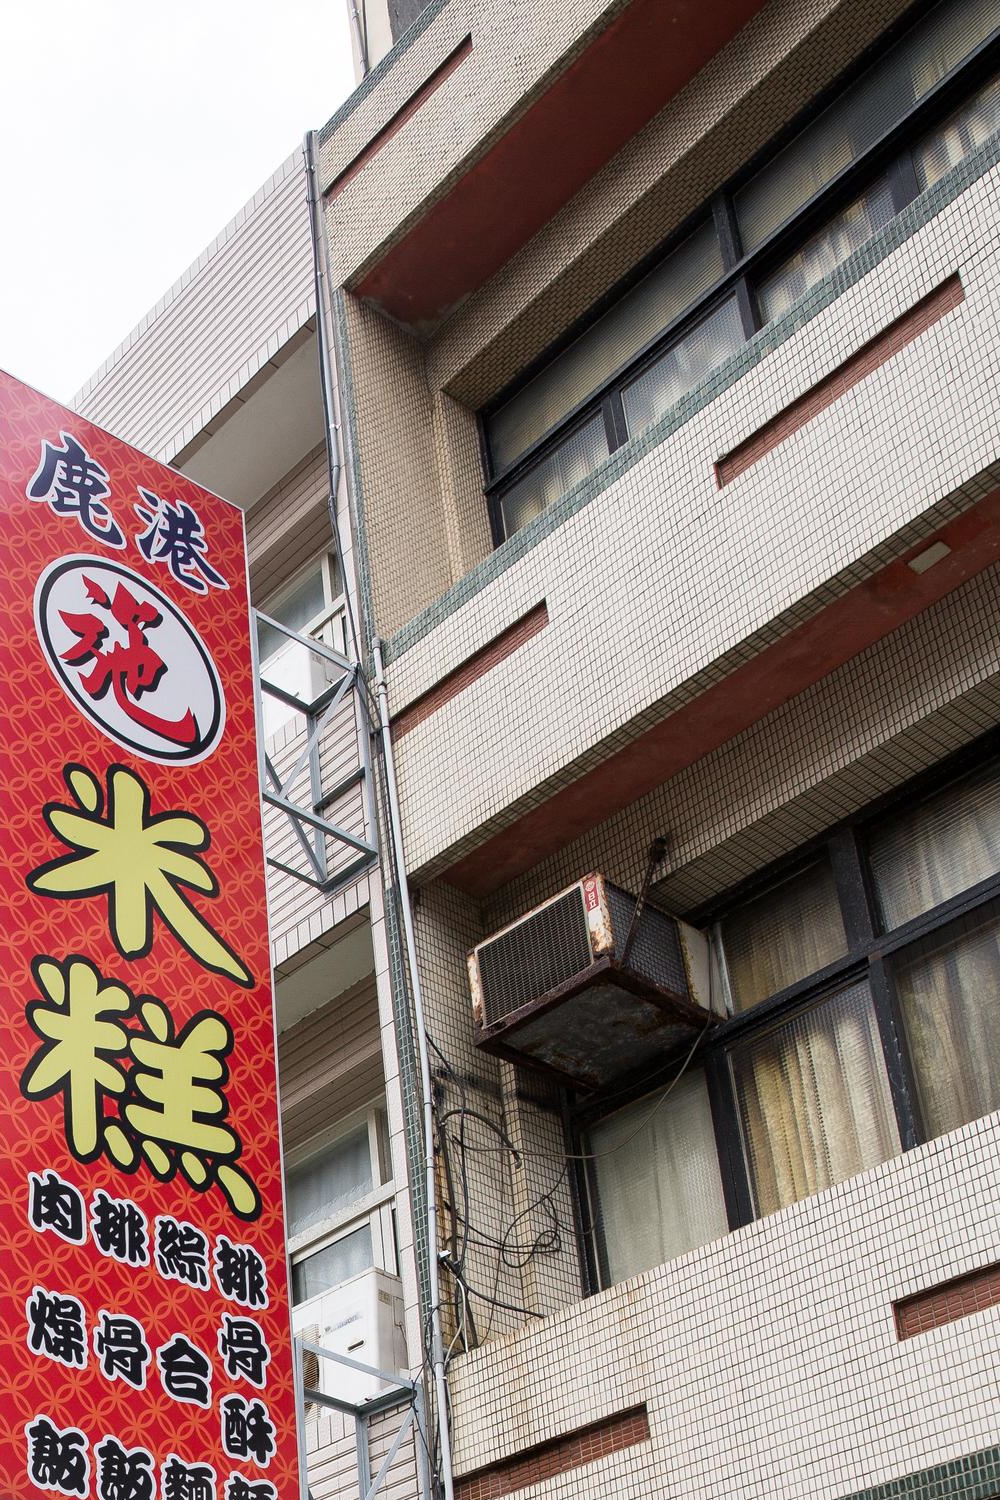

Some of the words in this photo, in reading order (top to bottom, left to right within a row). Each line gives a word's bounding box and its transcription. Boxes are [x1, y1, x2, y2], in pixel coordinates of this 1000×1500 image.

[27, 431, 230, 595] 鹿港
[20, 763, 261, 1221] 米糕
[25, 1169, 89, 1500] 肉燥飯
